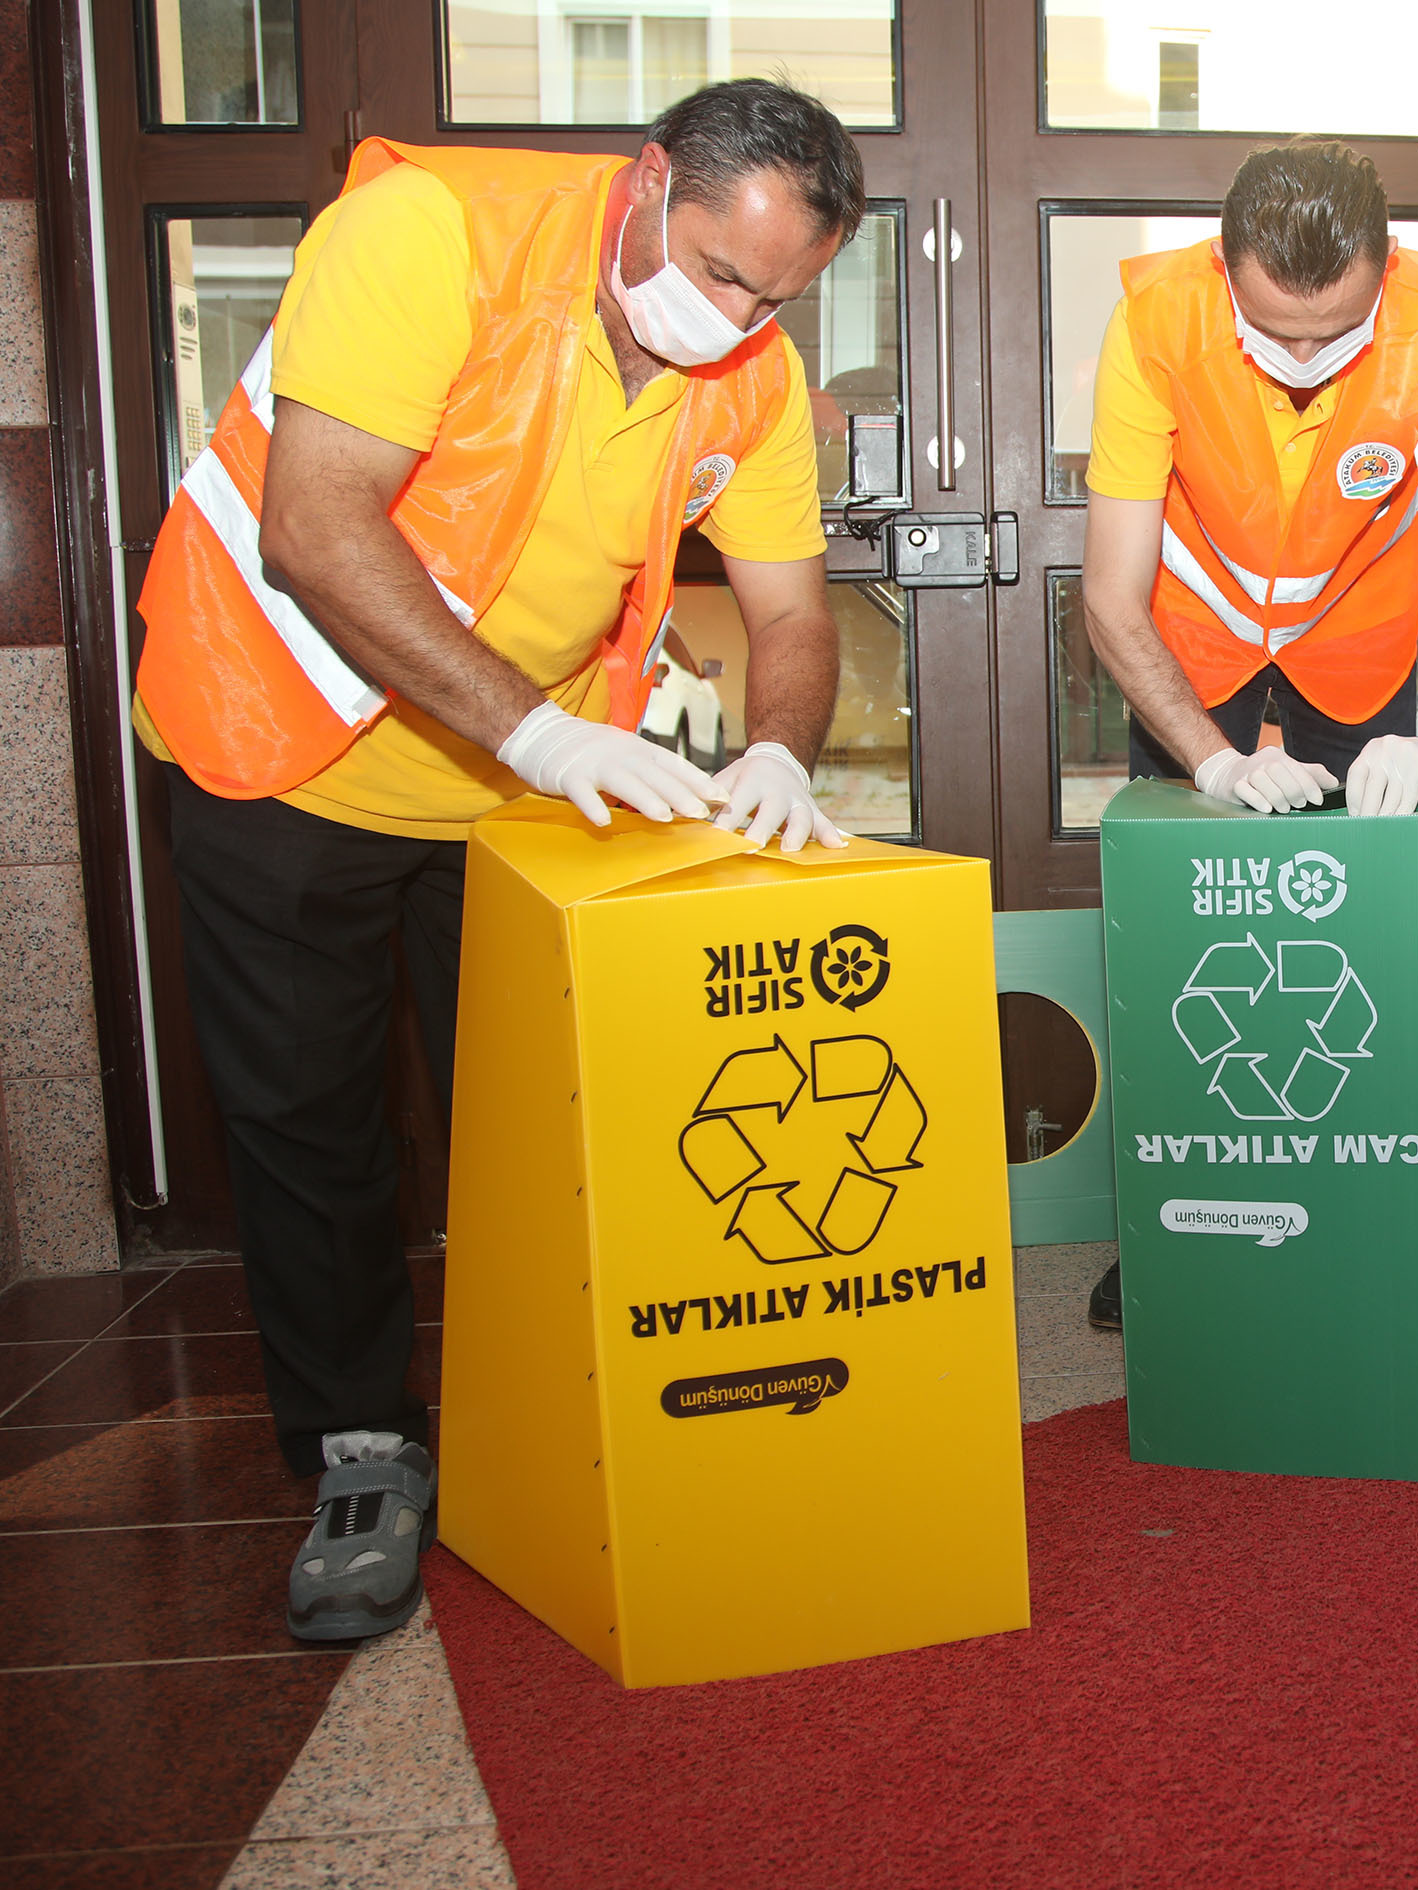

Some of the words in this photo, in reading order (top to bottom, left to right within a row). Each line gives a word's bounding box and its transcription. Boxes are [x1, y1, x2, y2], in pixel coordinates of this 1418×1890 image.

[1343, 453, 1362, 485] ATAKUM
[965, 531, 977, 567] KALE
[1191, 857, 1270, 887] ATIK
[1192, 888, 1273, 916] SIFIR
[702, 937, 800, 982] ATIK
[705, 977, 805, 1018] SIFIR
[1135, 1134, 1319, 1164] ATIKLAR
[1174, 1208, 1239, 1229] Dönüşüm
[1242, 1214, 1286, 1230] Güven
[821, 1256, 986, 1318] PLASTİK
[628, 1284, 809, 1338] ATIKLAR
[679, 1381, 762, 1411] Dönüşüm
[768, 1373, 822, 1397] Güven
